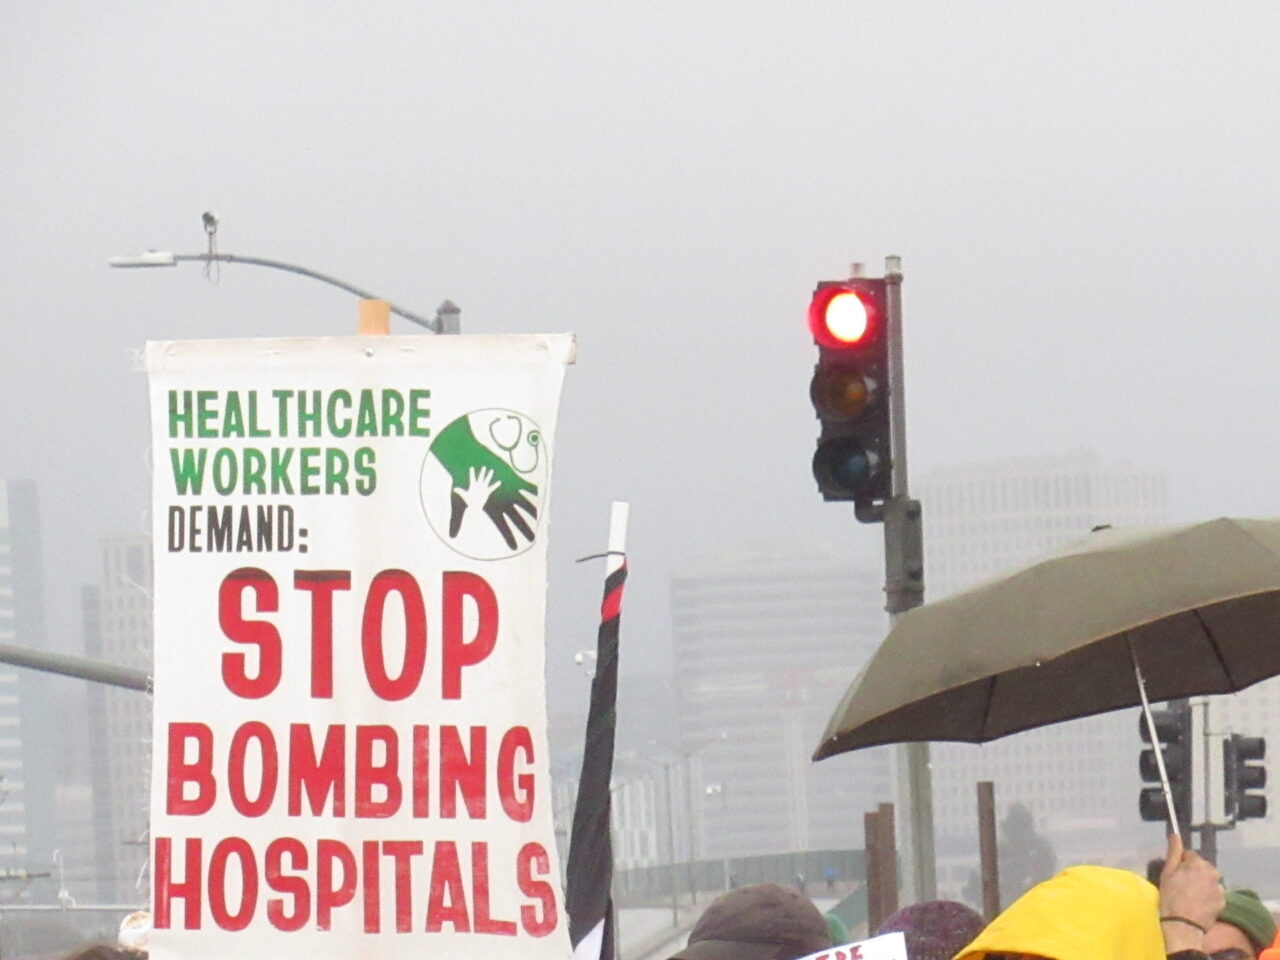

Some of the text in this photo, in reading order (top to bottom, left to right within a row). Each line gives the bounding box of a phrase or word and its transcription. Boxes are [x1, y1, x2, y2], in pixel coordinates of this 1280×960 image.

[168, 388, 431, 438] HEALTHCARE
[170, 447, 378, 496] WORKERS
[168, 504, 308, 553] DEMAND:
[218, 566, 499, 702] STOP
[165, 721, 536, 823] BOMBING
[153, 836, 559, 938] HOSPITALS
